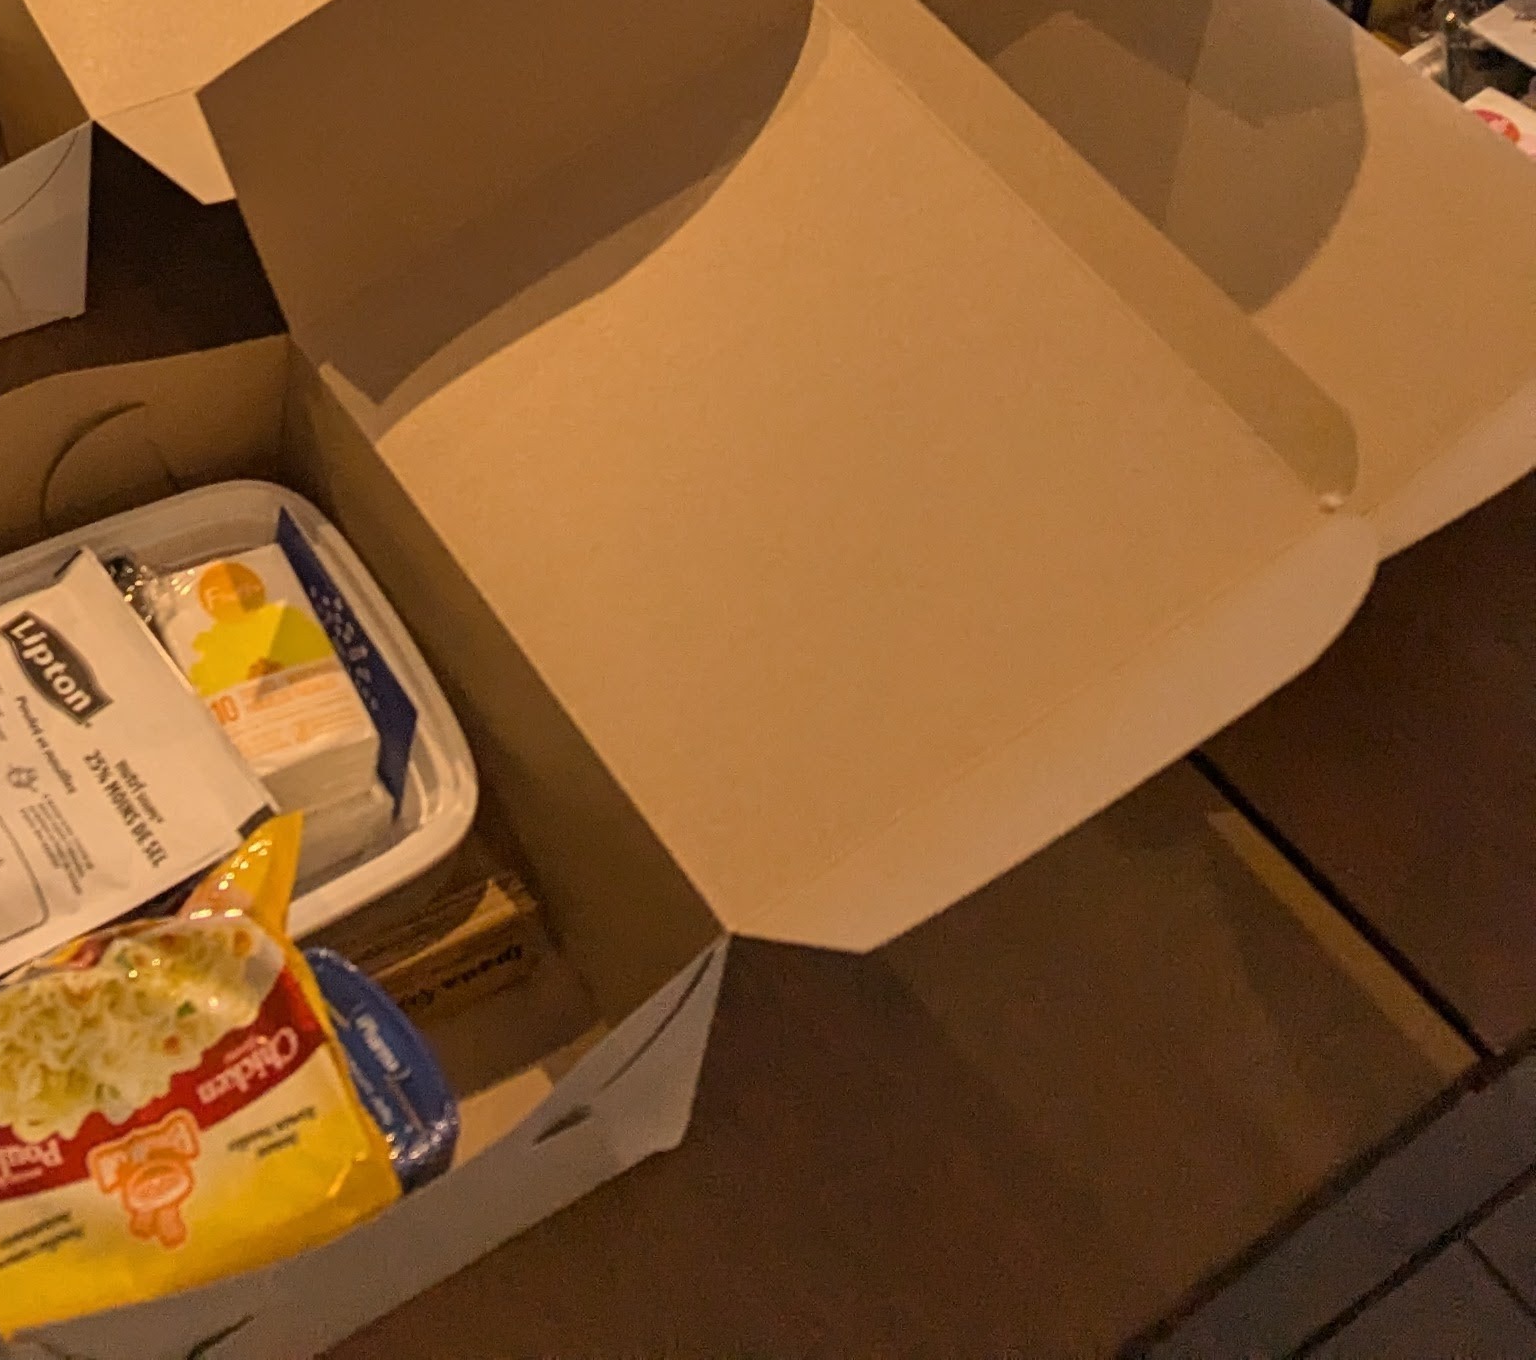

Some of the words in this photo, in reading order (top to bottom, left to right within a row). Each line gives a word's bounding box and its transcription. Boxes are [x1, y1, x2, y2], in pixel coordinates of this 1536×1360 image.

[10, 618, 93, 713] Lipton
[83, 748, 113, 785] 25%
[104, 779, 140, 827] MOINS
[130, 820, 155, 844] DE
[143, 838, 168, 869] SEL
[196, 1027, 299, 1104] Chicken
